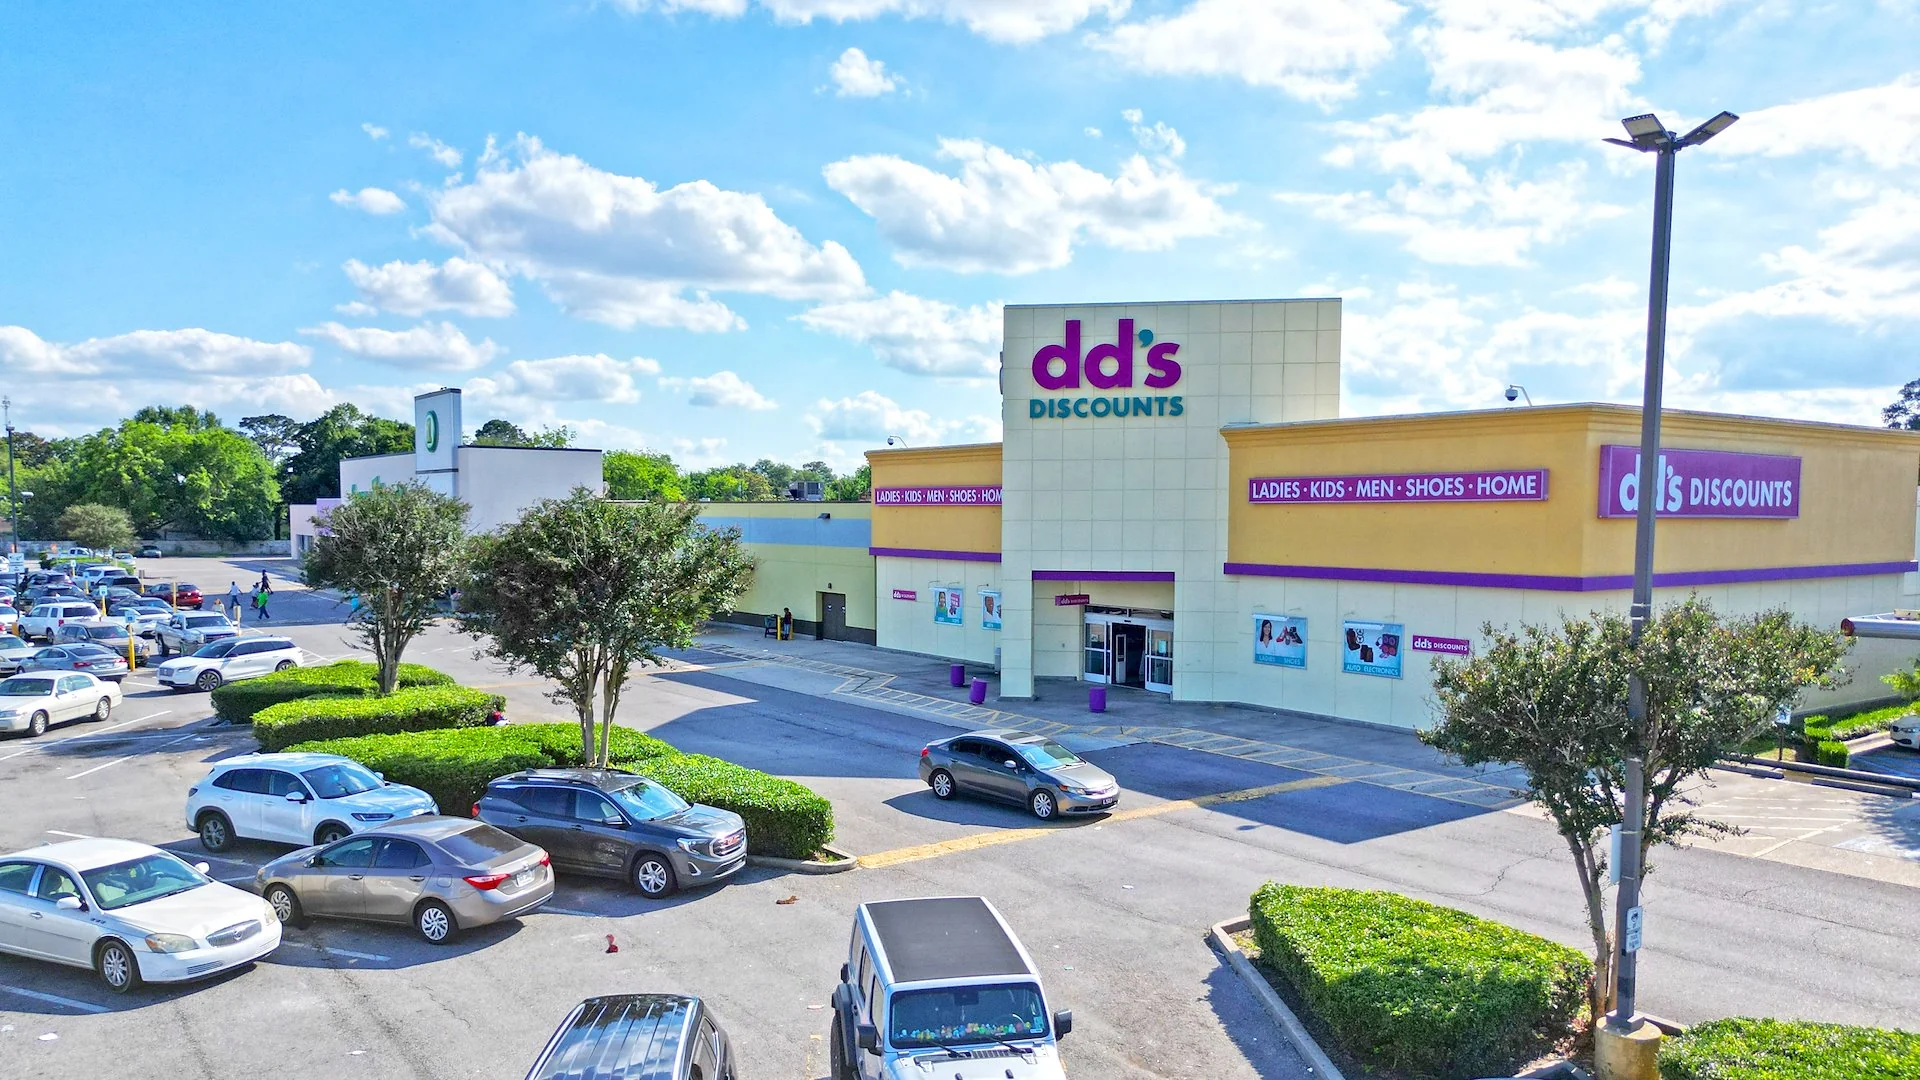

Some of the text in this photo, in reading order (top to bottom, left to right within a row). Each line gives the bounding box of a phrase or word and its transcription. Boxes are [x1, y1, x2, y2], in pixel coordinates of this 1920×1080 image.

[1032, 319, 1182, 390] dd's
[1029, 396, 1184, 419] DISCOUNTS
[876, 489, 1002, 503] LADIES KIDS MEN SHOES HOM
[1252, 475, 1537, 499] LADIES KIDS MEN SHOES HOME
[1690, 477, 1792, 507] DISCOUNTS
[1414, 638, 1468, 651] dd's DISCOUNTS
[1283, 657, 1301, 666] SHOES
[1346, 664, 1399, 676] AUTO ELECTRONICS
